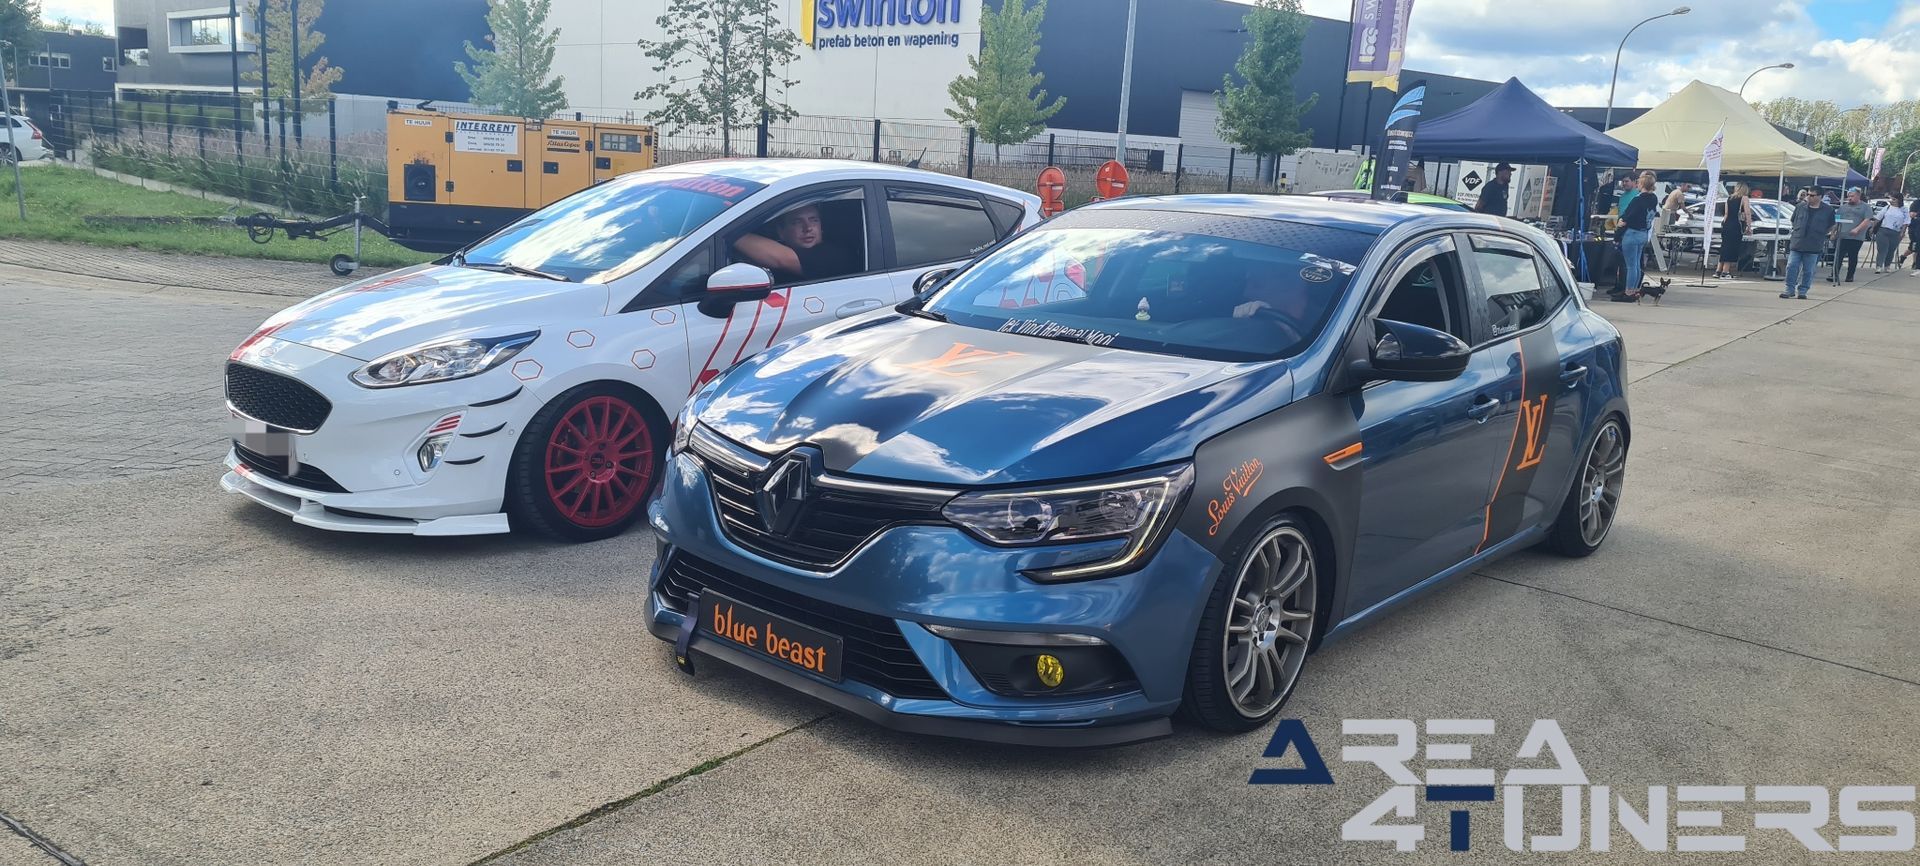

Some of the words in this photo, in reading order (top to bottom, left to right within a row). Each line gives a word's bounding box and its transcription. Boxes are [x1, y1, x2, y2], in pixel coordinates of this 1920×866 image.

[817, 0, 961, 28] swinton
[819, 35, 851, 50] prefab
[854, 34, 884, 47] beton
[887, 35, 900, 46] en
[904, 31, 959, 47] wapening
[456, 121, 517, 133] INTERRENT
[1464, 176, 1481, 185] VDF
[1207, 491, 1236, 536] Louis
[1222, 457, 1264, 498] Vuitton
[713, 603, 758, 648] blue
[766, 622, 827, 672] beast
